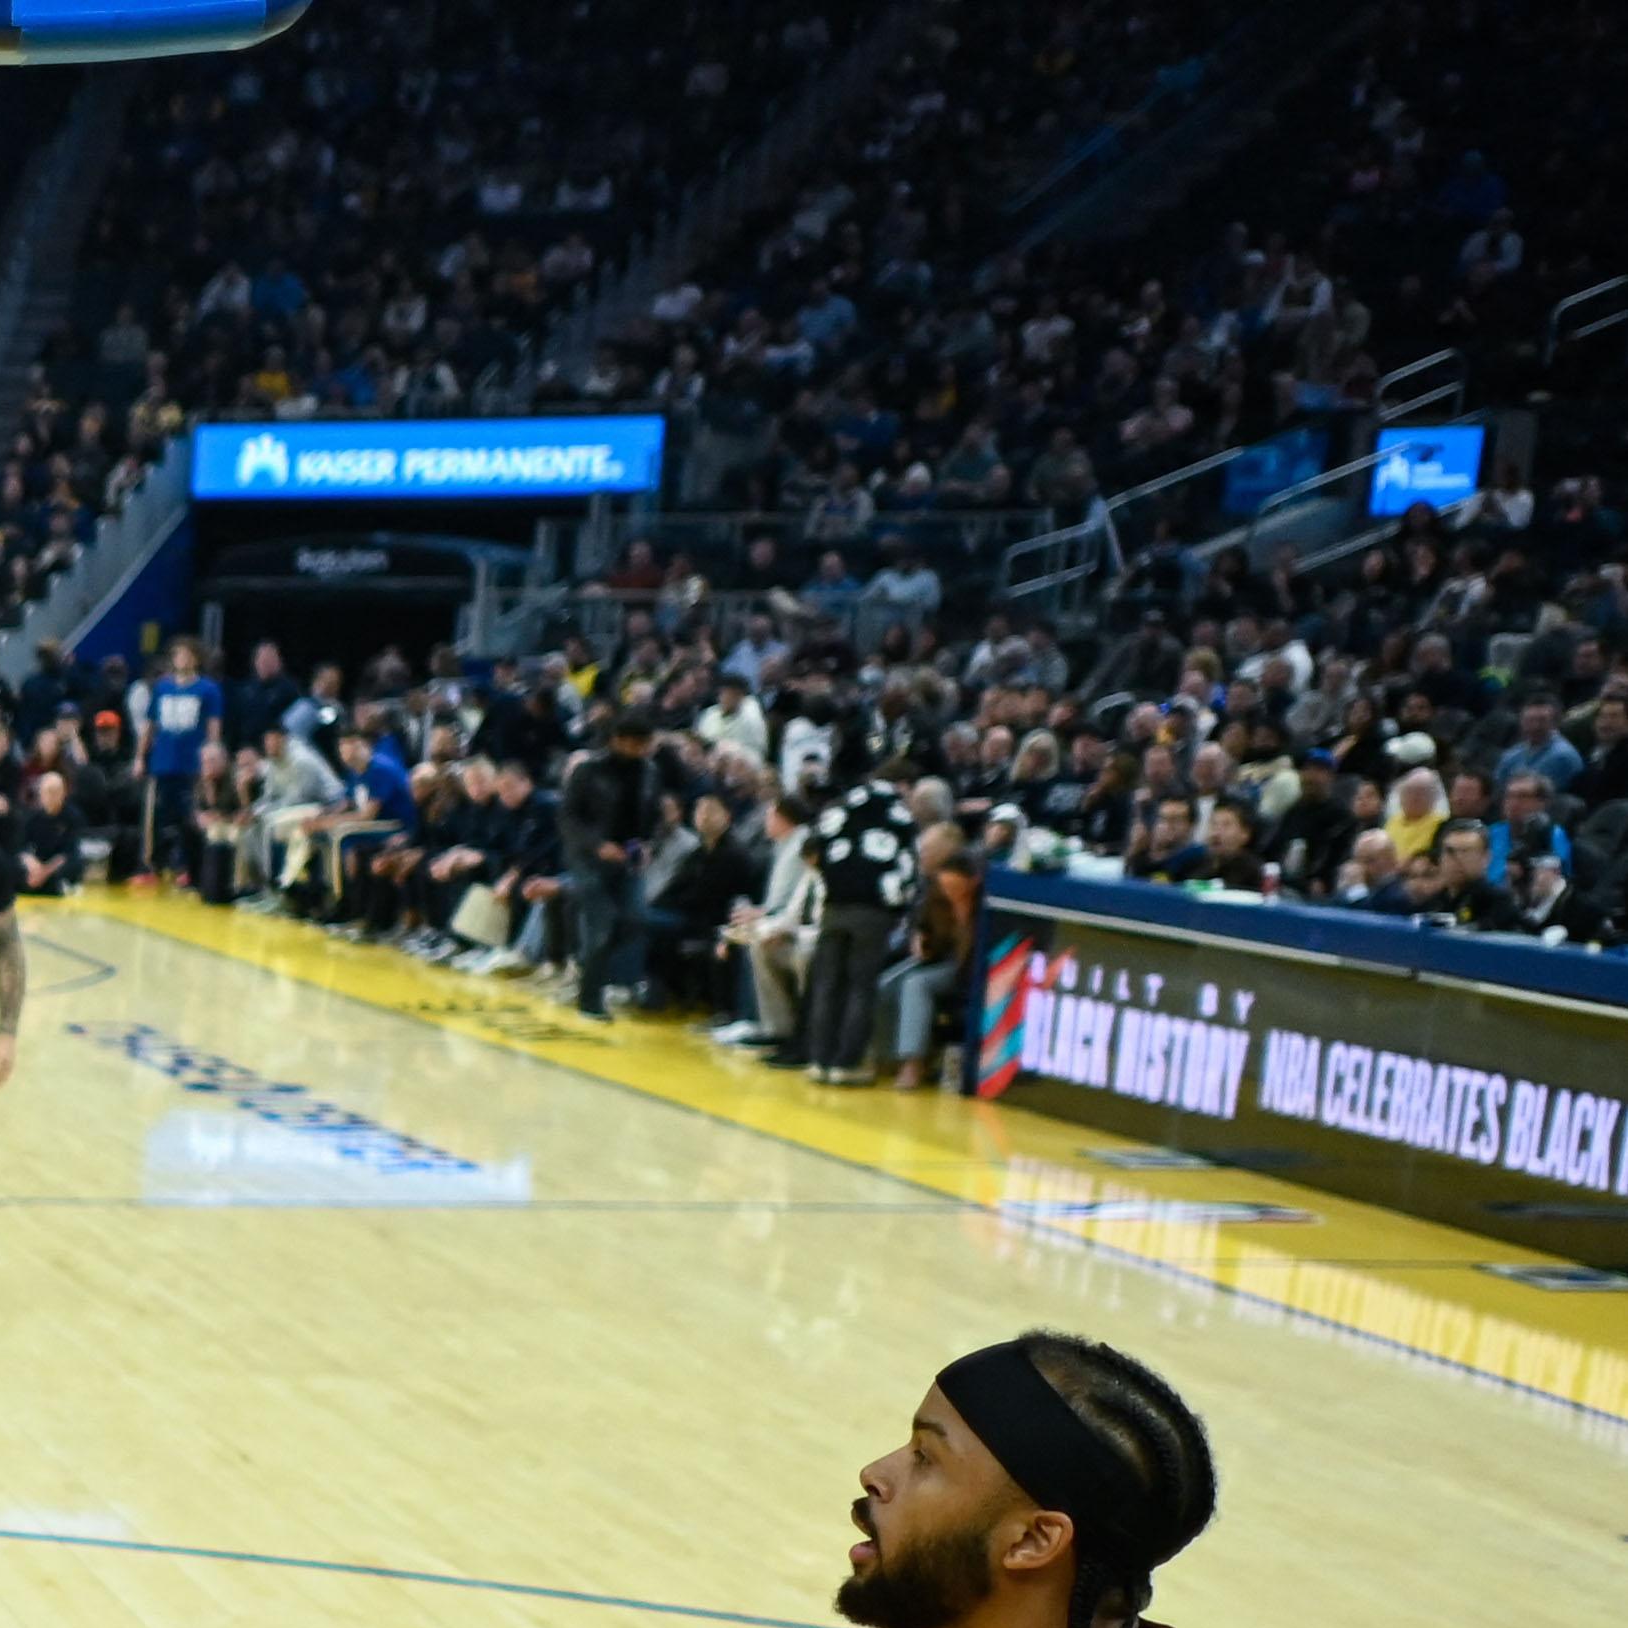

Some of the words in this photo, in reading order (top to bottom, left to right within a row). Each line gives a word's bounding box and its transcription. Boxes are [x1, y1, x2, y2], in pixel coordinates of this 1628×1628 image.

[296, 449, 397, 485] KAISER
[402, 444, 614, 485] PERMANENTE
[1021, 985, 1117, 1089] BLACK
[1113, 1006, 1251, 1120] HISTORY
[1259, 1027, 1321, 1121] NBA
[1321, 1040, 1509, 1166] CELEBRATES
[1501, 1078, 1622, 1190] BLACK
